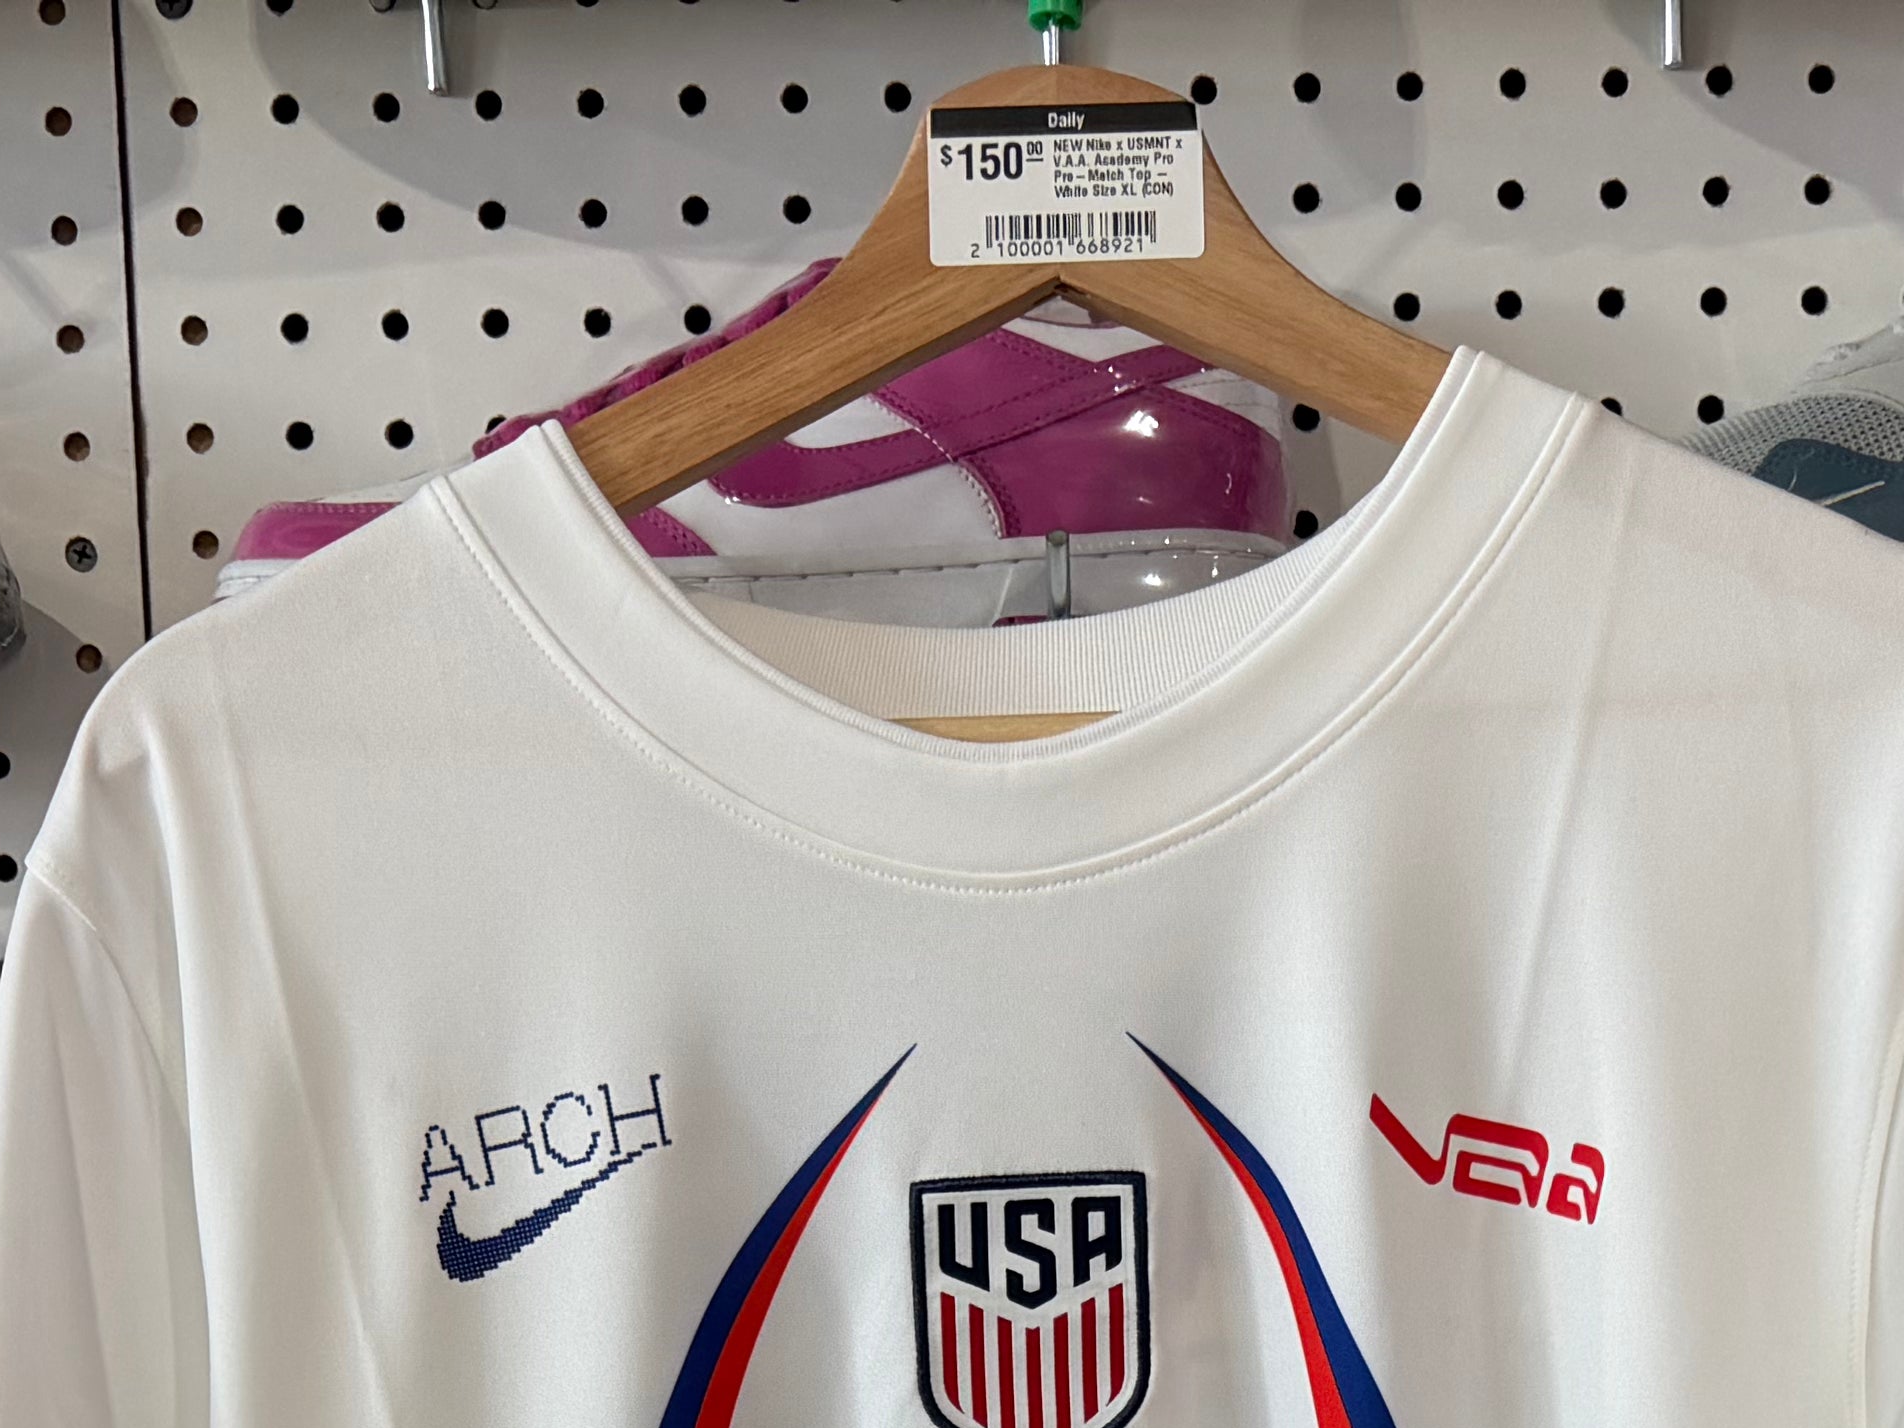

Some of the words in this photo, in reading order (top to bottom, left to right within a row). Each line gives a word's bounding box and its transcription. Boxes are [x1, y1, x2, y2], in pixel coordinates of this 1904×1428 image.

[1048, 111, 1086, 130] Daily
[1053, 138, 1083, 153] NEW
[1086, 137, 1112, 152] Nike
[1116, 140, 1124, 151] x
[1127, 135, 1172, 151] USMNT
[1175, 138, 1183, 149] x
[1053, 153, 1090, 168] V.A.A.
[1094, 152, 1150, 168] Academy
[1153, 151, 1175, 164] Pro
[1087, 168, 1125, 183] Match
[1128, 167, 1152, 183] Top
[1054, 184, 1088, 198] White
[1092, 183, 1117, 197] Size
[1120, 183, 1137, 197] XL
[1141, 181, 1174, 198] (CON)
[970, 243, 981, 259] 2
[996, 240, 1064, 258] 100001
[1076, 237, 1144, 255] 668921
[418, 1072, 674, 1204] ARCH
[936, 1190, 1126, 1308] USA
